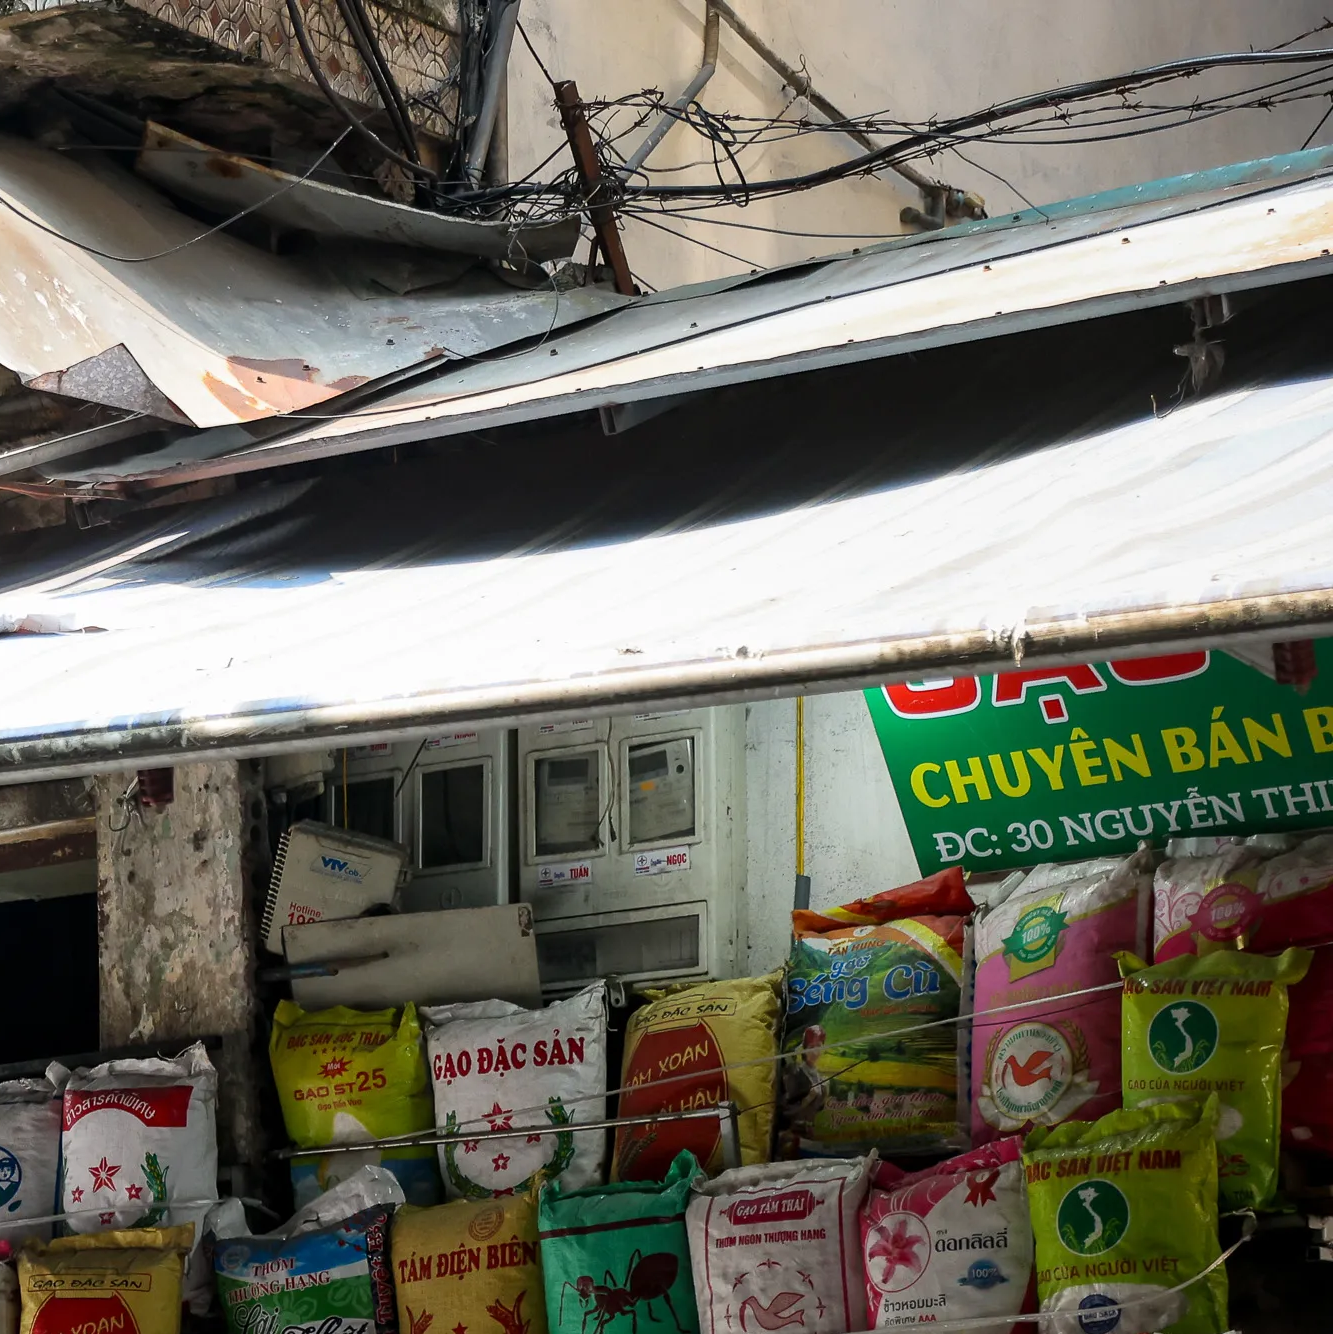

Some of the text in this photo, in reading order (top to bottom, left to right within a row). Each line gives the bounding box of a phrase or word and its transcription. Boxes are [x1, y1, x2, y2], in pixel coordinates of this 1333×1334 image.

[910, 727, 1151, 808] CHUYÊN
[1161, 706, 1293, 774] BÁN
[933, 787, 1246, 863] ĐC: 30 NGUYỄN
[788, 961, 941, 1015] Séng Cù
[1229, 978, 1273, 997] NAM
[434, 1028, 586, 1086] GẠO ĐẶC SẢN
[658, 1039, 710, 1076] XOAN
[1137, 1149, 1181, 1171] NAM
[738, 1234, 763, 1246] NGON
[251, 1256, 296, 1278] THƠM
[399, 1234, 539, 1284] TÁM ĐIỆN BIÊN
[285, 1271, 331, 1292] HẠNG
[918, 1313, 937, 1324] AAA
